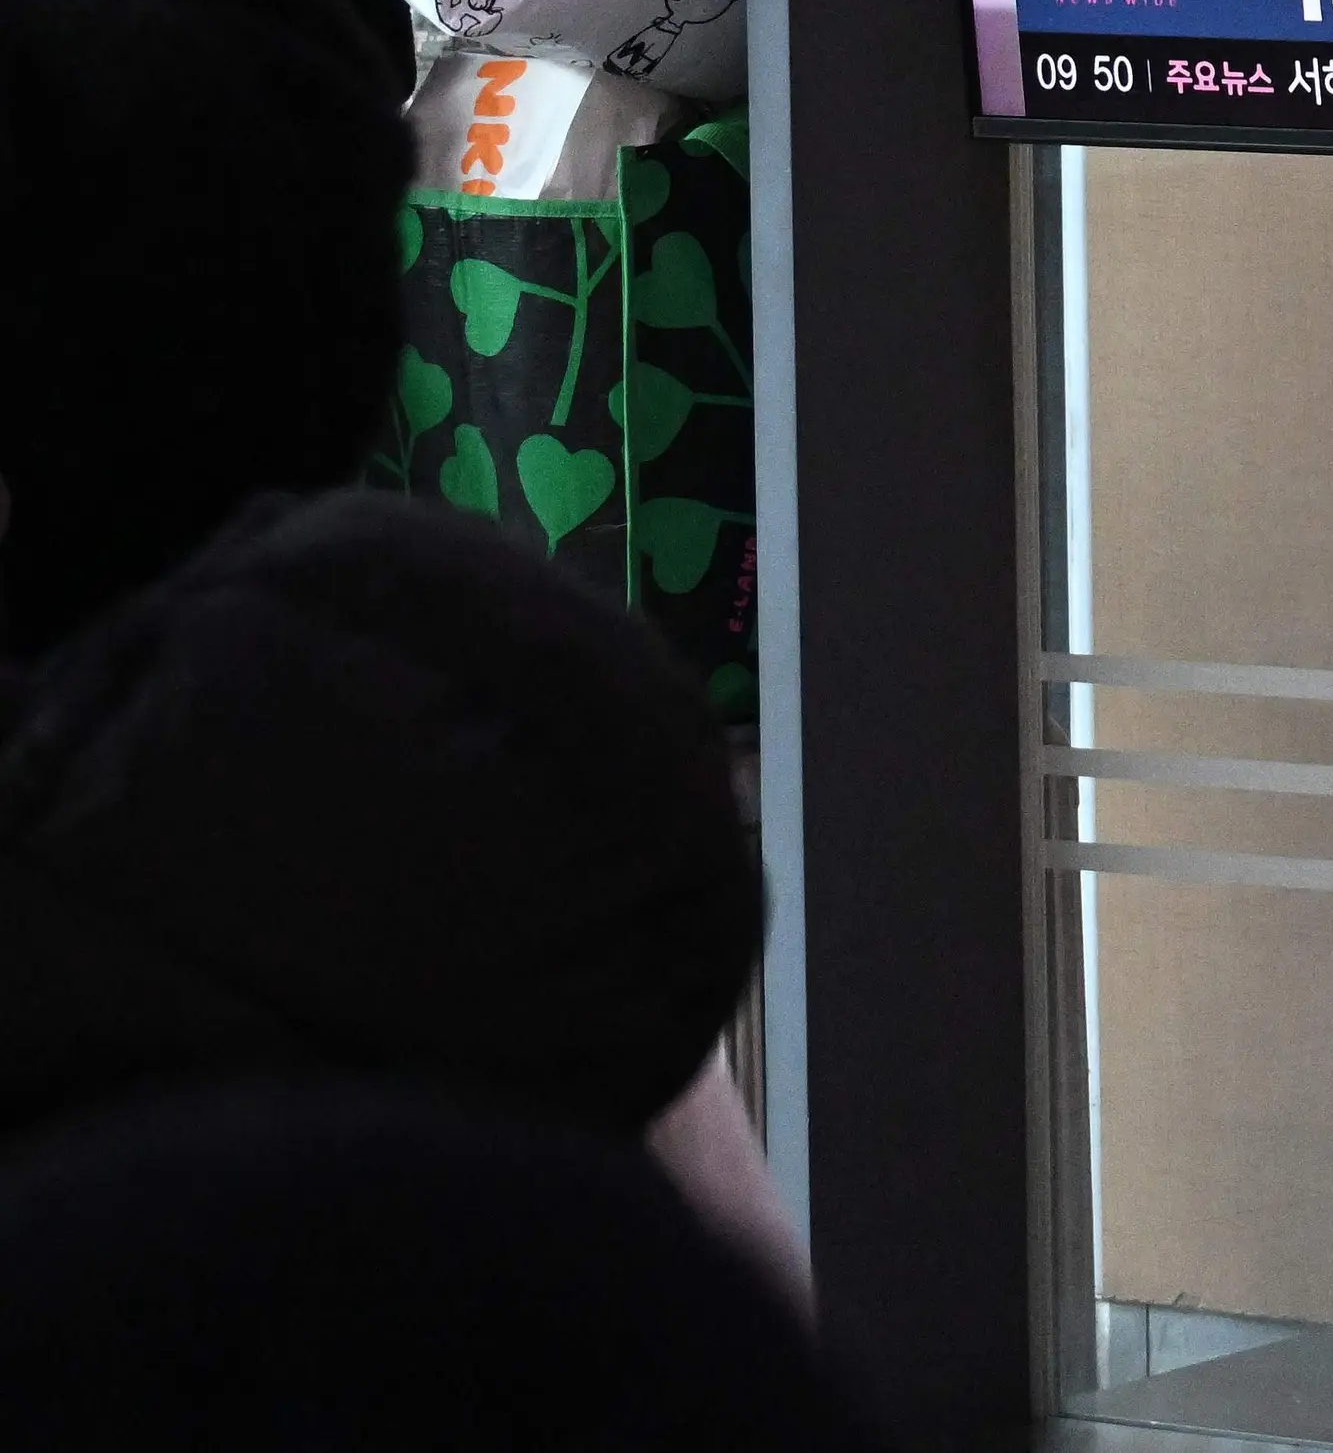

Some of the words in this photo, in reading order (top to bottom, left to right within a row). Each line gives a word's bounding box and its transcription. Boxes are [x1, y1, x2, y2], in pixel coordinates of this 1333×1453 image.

[1035, 53, 1077, 91] 09
[1092, 54, 1134, 93] 50
[1166, 58, 1275, 96] 주요뉴스
